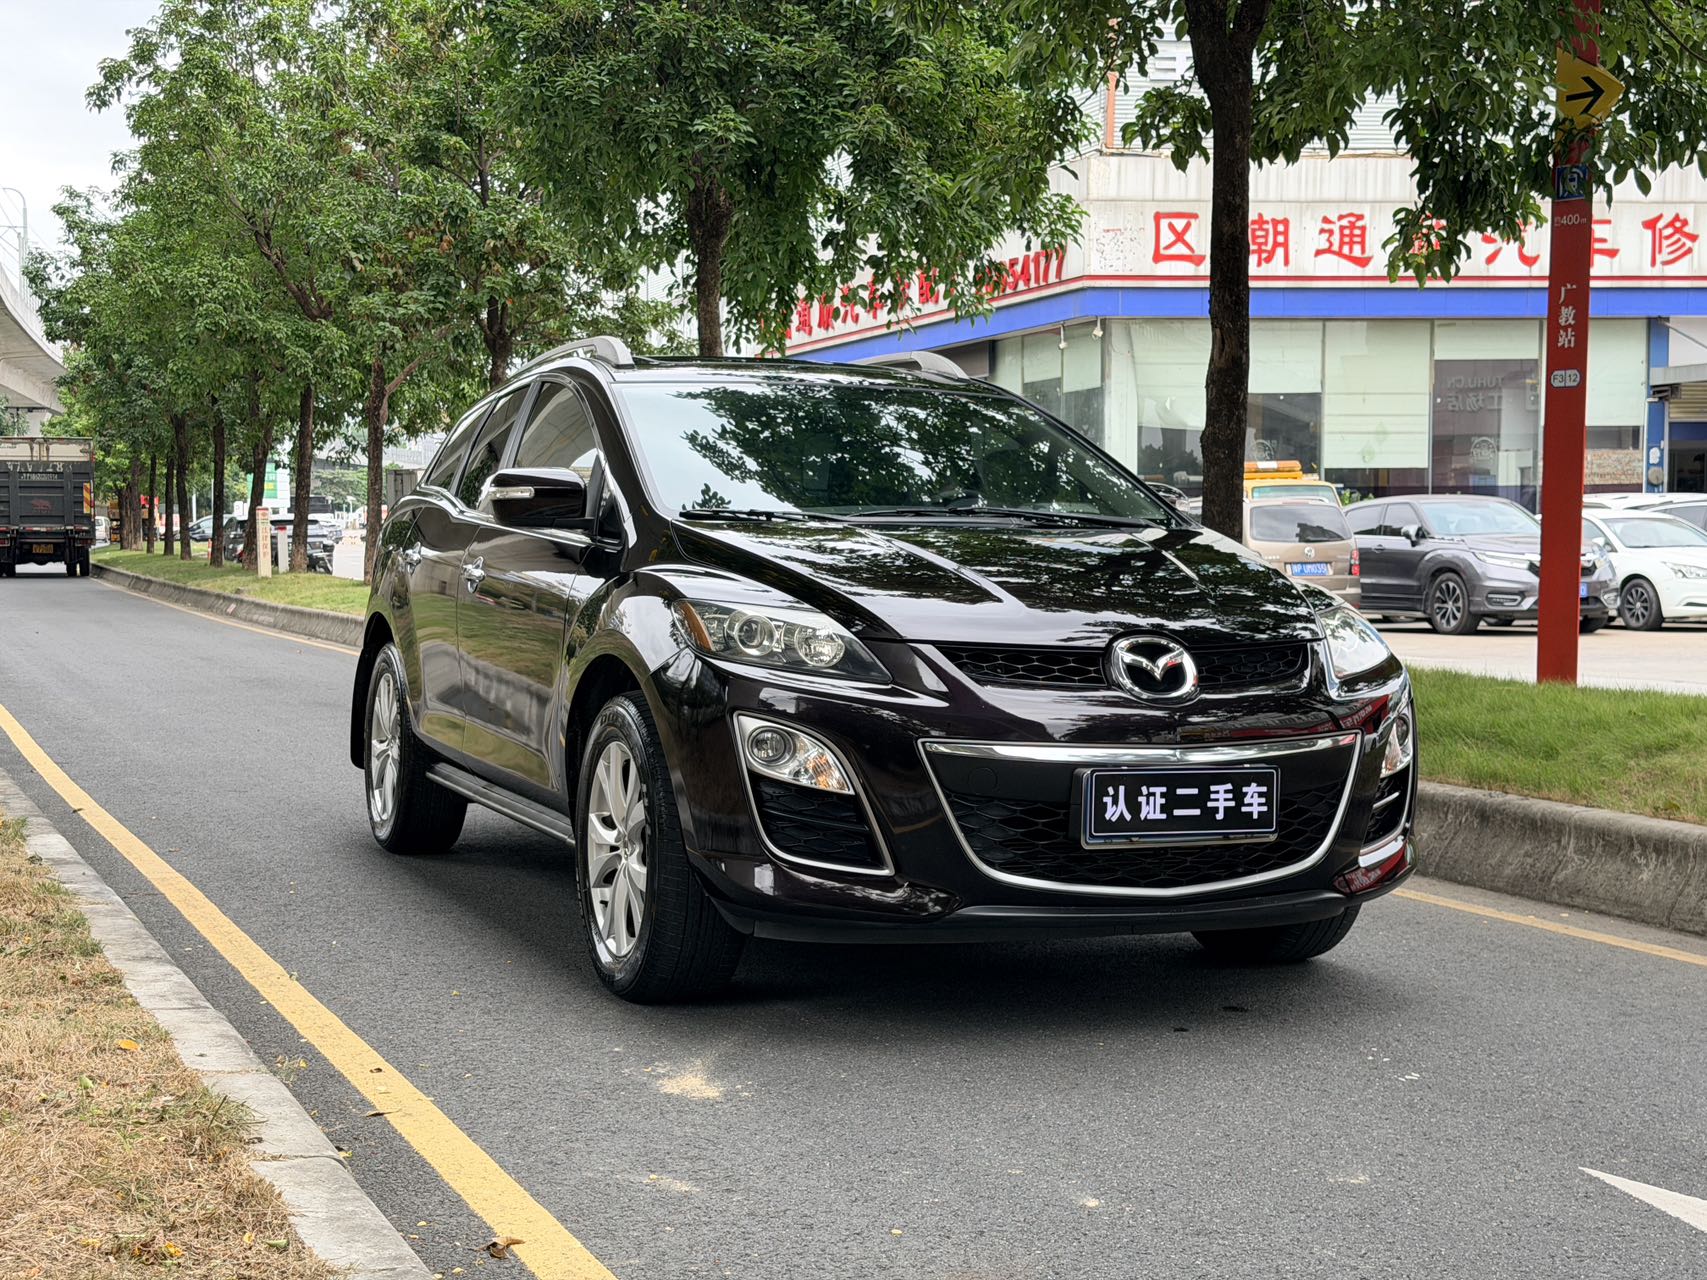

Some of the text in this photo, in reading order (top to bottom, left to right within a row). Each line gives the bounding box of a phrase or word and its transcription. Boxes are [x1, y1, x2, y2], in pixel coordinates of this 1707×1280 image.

[1557, 283, 1576, 349] 广教站
[1568, 373, 1579, 383] 12
[1103, 783, 1268, 822] 认证二手车
